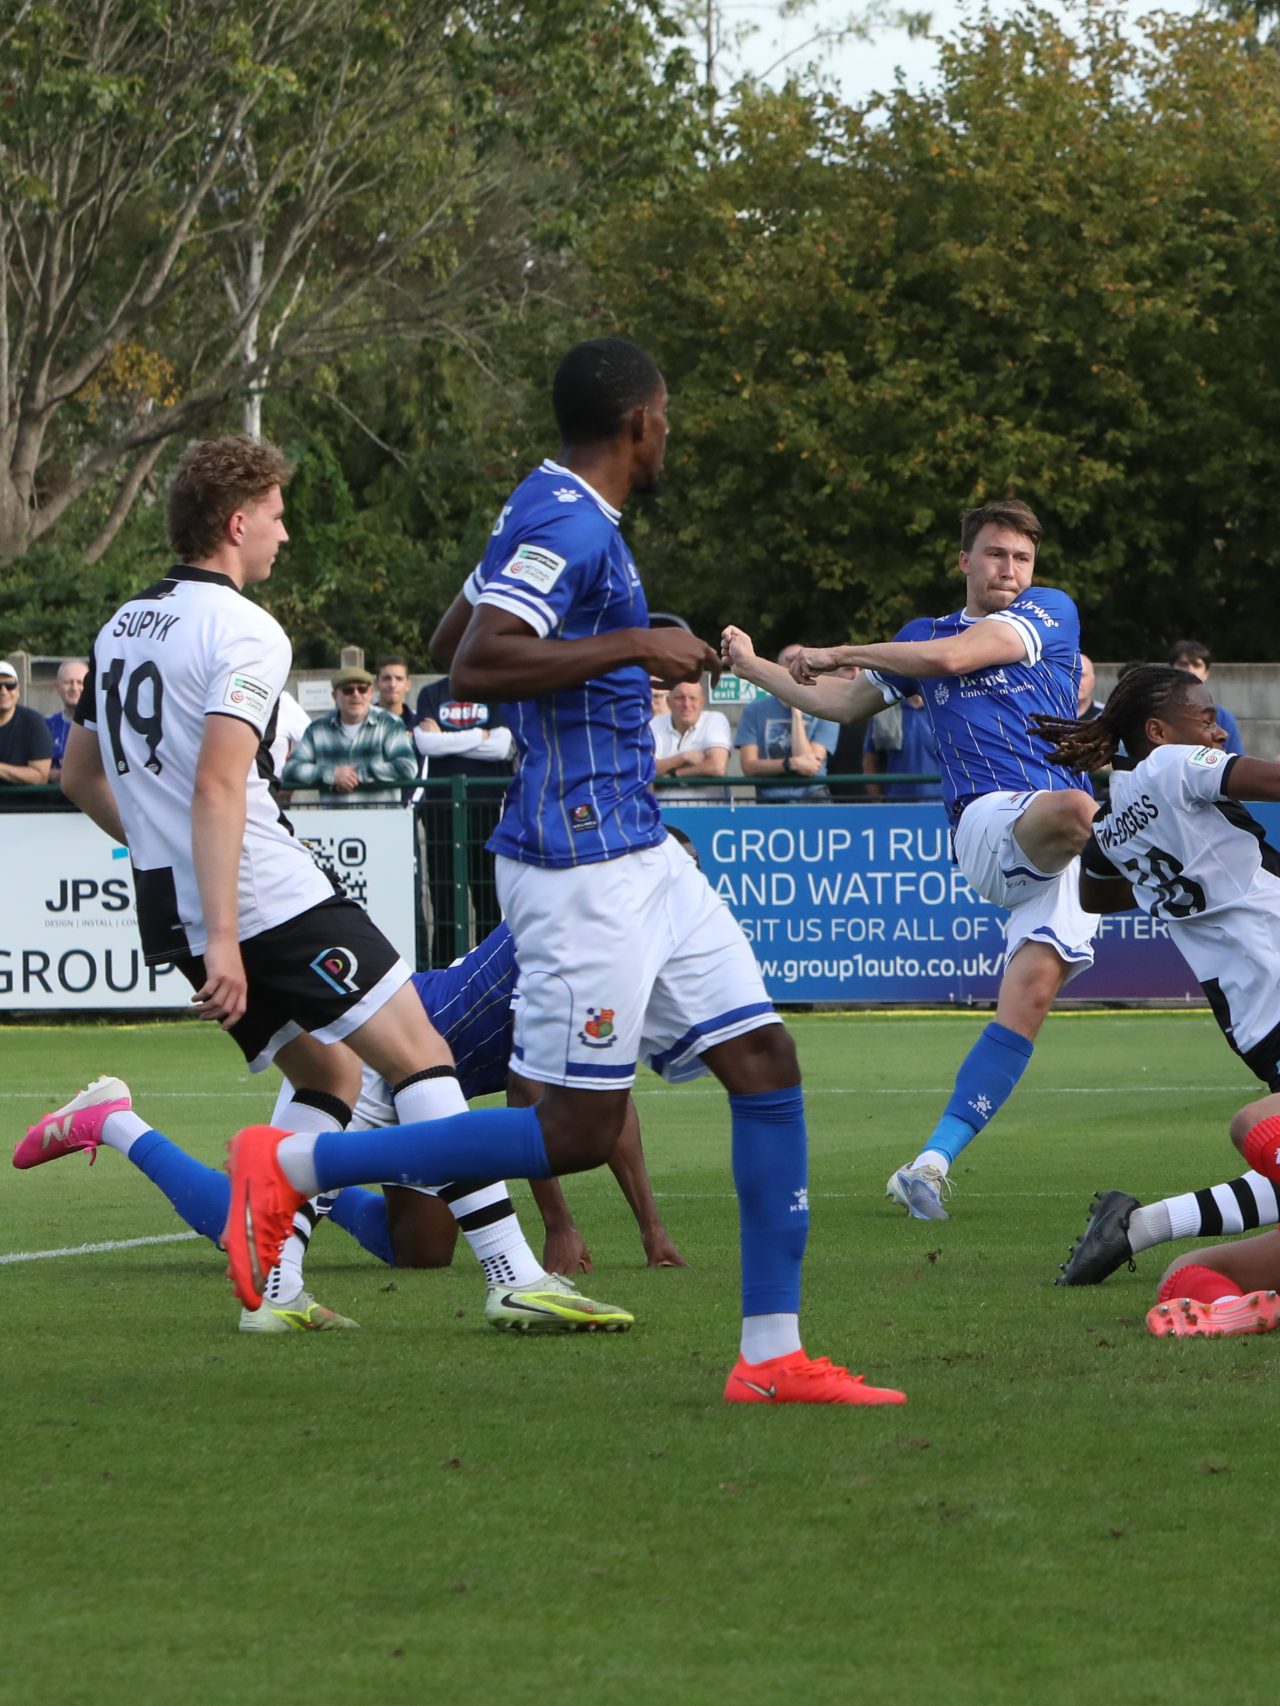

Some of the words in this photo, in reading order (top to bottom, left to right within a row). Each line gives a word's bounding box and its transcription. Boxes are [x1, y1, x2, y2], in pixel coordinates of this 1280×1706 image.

[113, 610, 180, 642] SUPYK
[713, 690, 736, 699] exit
[102, 658, 163, 777] 19
[712, 828, 851, 863] GROUP
[861, 828, 876, 862] 1
[45, 879, 130, 912] JPS
[715, 872, 796, 906] AND
[807, 868, 992, 906] WATFOR
[740, 918, 780, 943] SIT
[786, 918, 823, 943] US
[831, 917, 886, 942] FOR
[892, 917, 945, 942] ALL
[952, 916, 989, 942] OF
